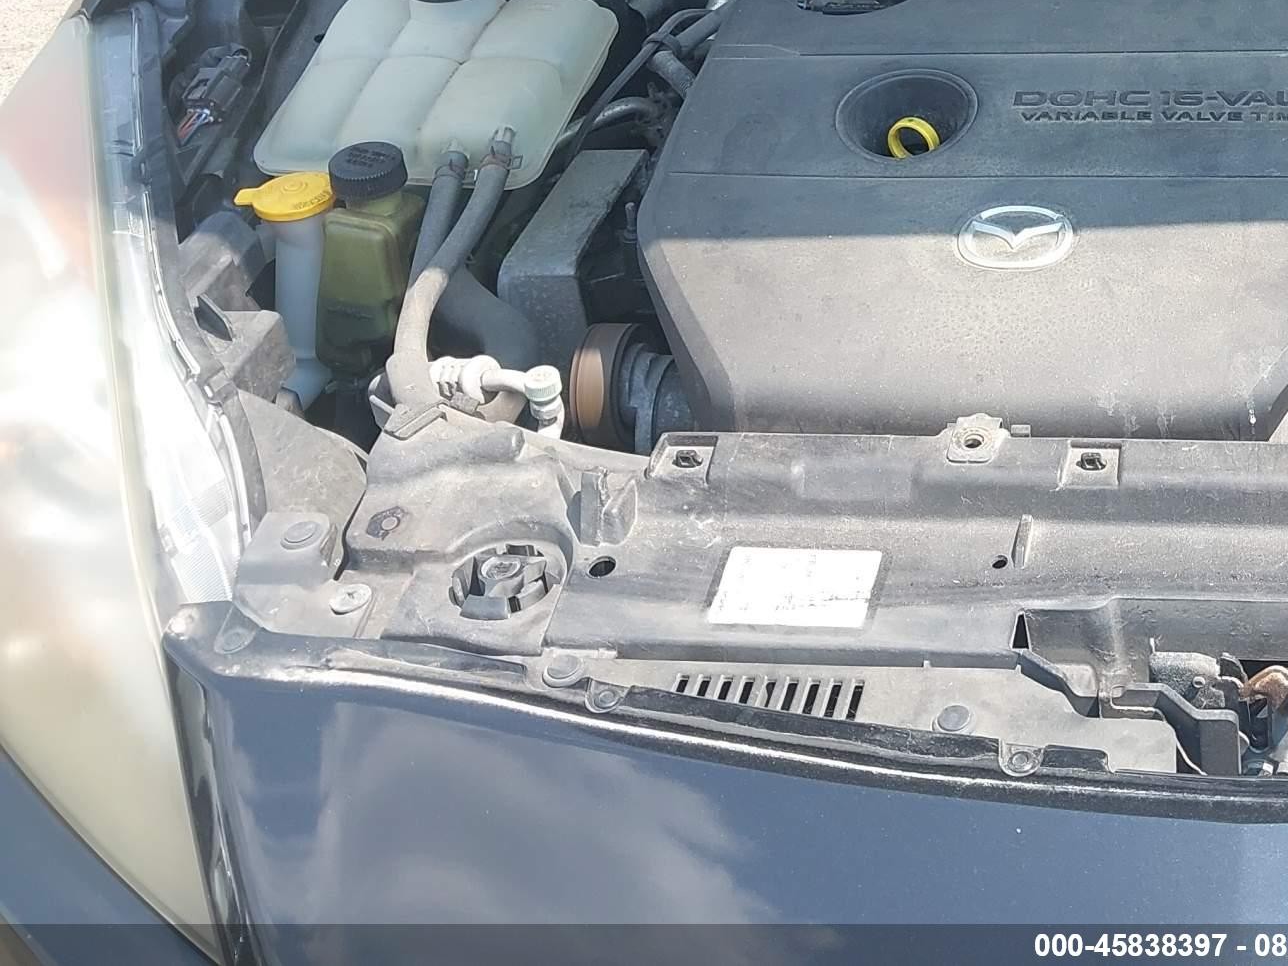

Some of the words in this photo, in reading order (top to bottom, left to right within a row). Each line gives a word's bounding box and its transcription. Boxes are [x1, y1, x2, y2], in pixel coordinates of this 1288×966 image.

[1012, 89, 1151, 108] DOHC
[1020, 110, 1153, 122] VARIABLE
[1160, 110, 1244, 122] VALVE
